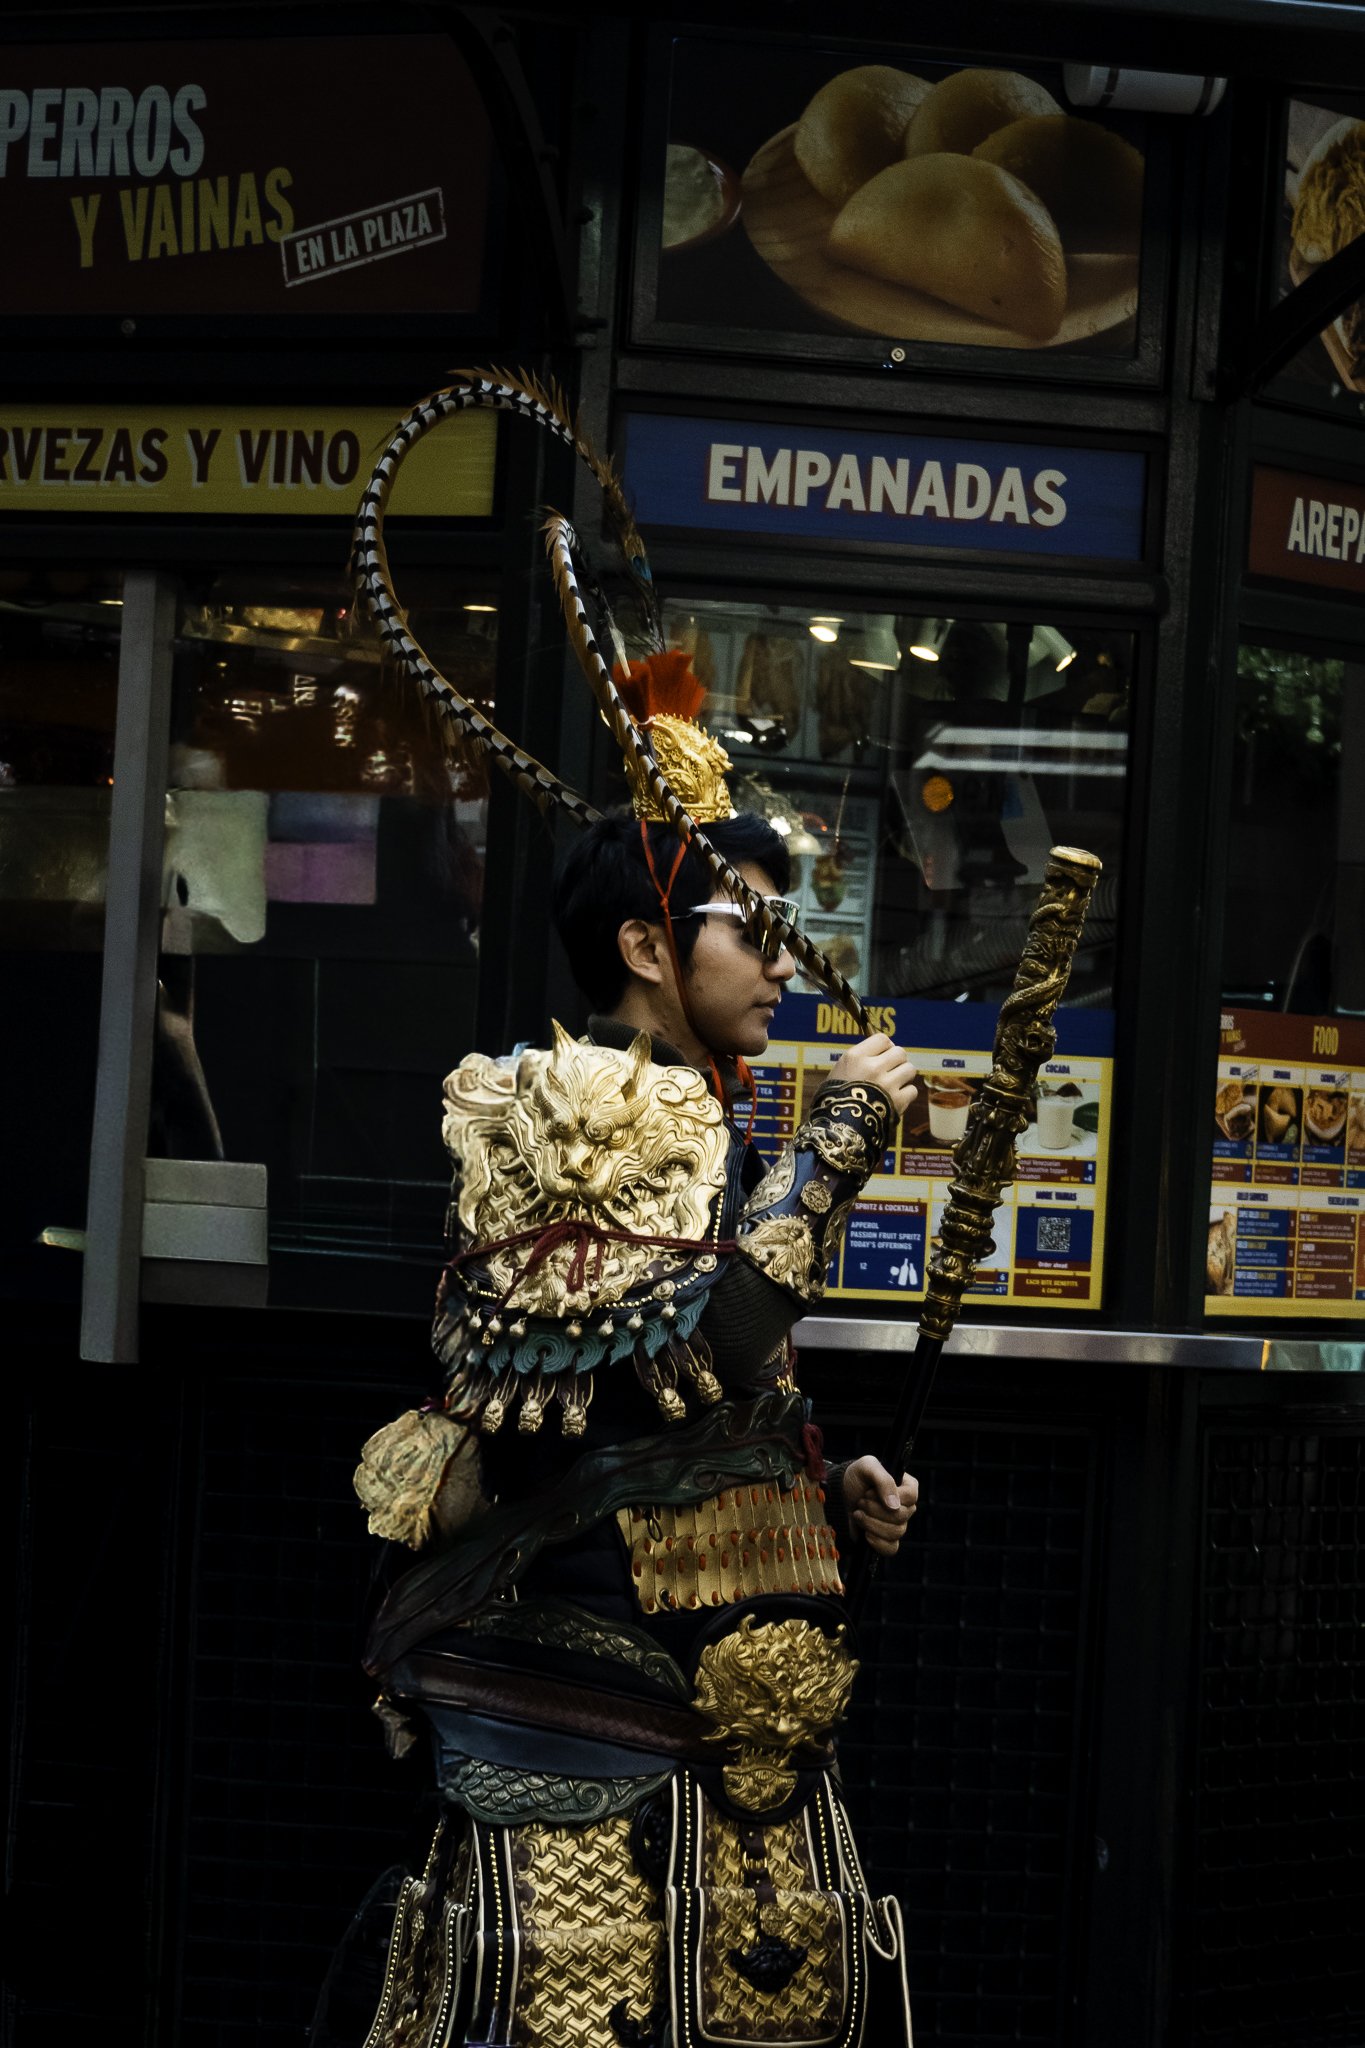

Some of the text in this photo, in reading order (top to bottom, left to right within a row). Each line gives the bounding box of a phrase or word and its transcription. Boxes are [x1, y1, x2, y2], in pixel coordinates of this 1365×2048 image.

[0, 84, 208, 178] PERROS
[70, 166, 295, 268] Y VAINAS
[295, 202, 432, 274] EN LA PLAZA
[188, 429, 221, 483] Y
[239, 429, 359, 485] VINO
[707, 443, 1067, 527] EMPANADAS
[1312, 1025, 1339, 1055] FOOD
[1045, 1064, 1070, 1074] COCADA
[760, 1087, 773, 1095] TEA
[855, 1202, 878, 1211] SPRITZ
[885, 1204, 919, 1213] COCKTAILS
[851, 1221, 879, 1229] APPEROL
[850, 1231, 921, 1241] PASSION FRUIT SPRITZ
[850, 1240, 912, 1250] TODAY'S OFFERINGS
[859, 1262, 867, 1270] 12
